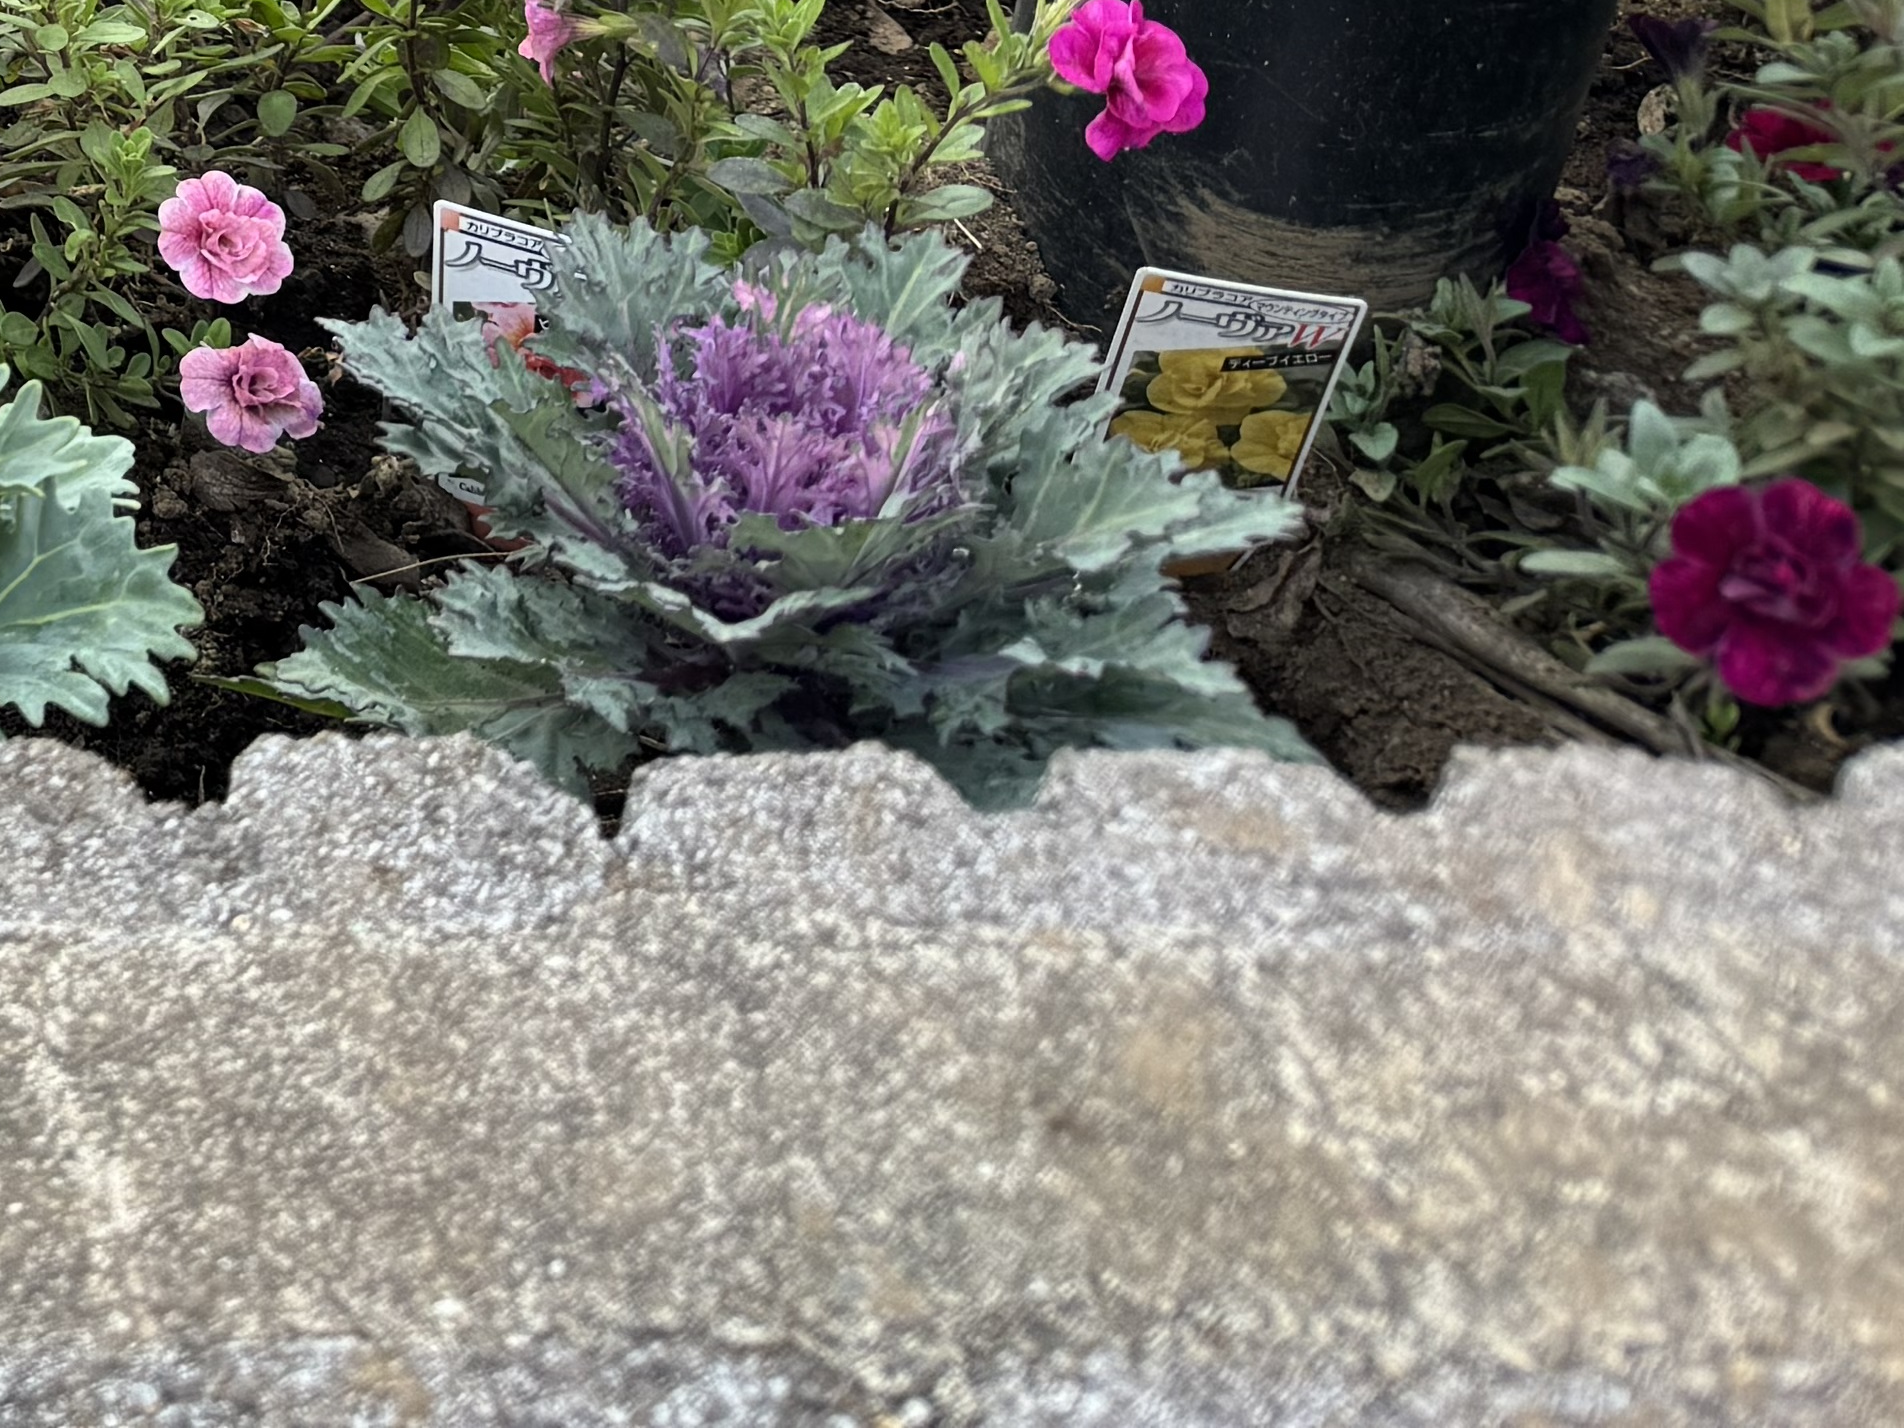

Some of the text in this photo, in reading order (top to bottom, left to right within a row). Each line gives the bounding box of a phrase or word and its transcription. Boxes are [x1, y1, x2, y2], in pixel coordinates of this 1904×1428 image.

[444, 240, 559, 293] ノーヴ
[1171, 284, 1350, 322] カリブラコア マウンティングタイプ
